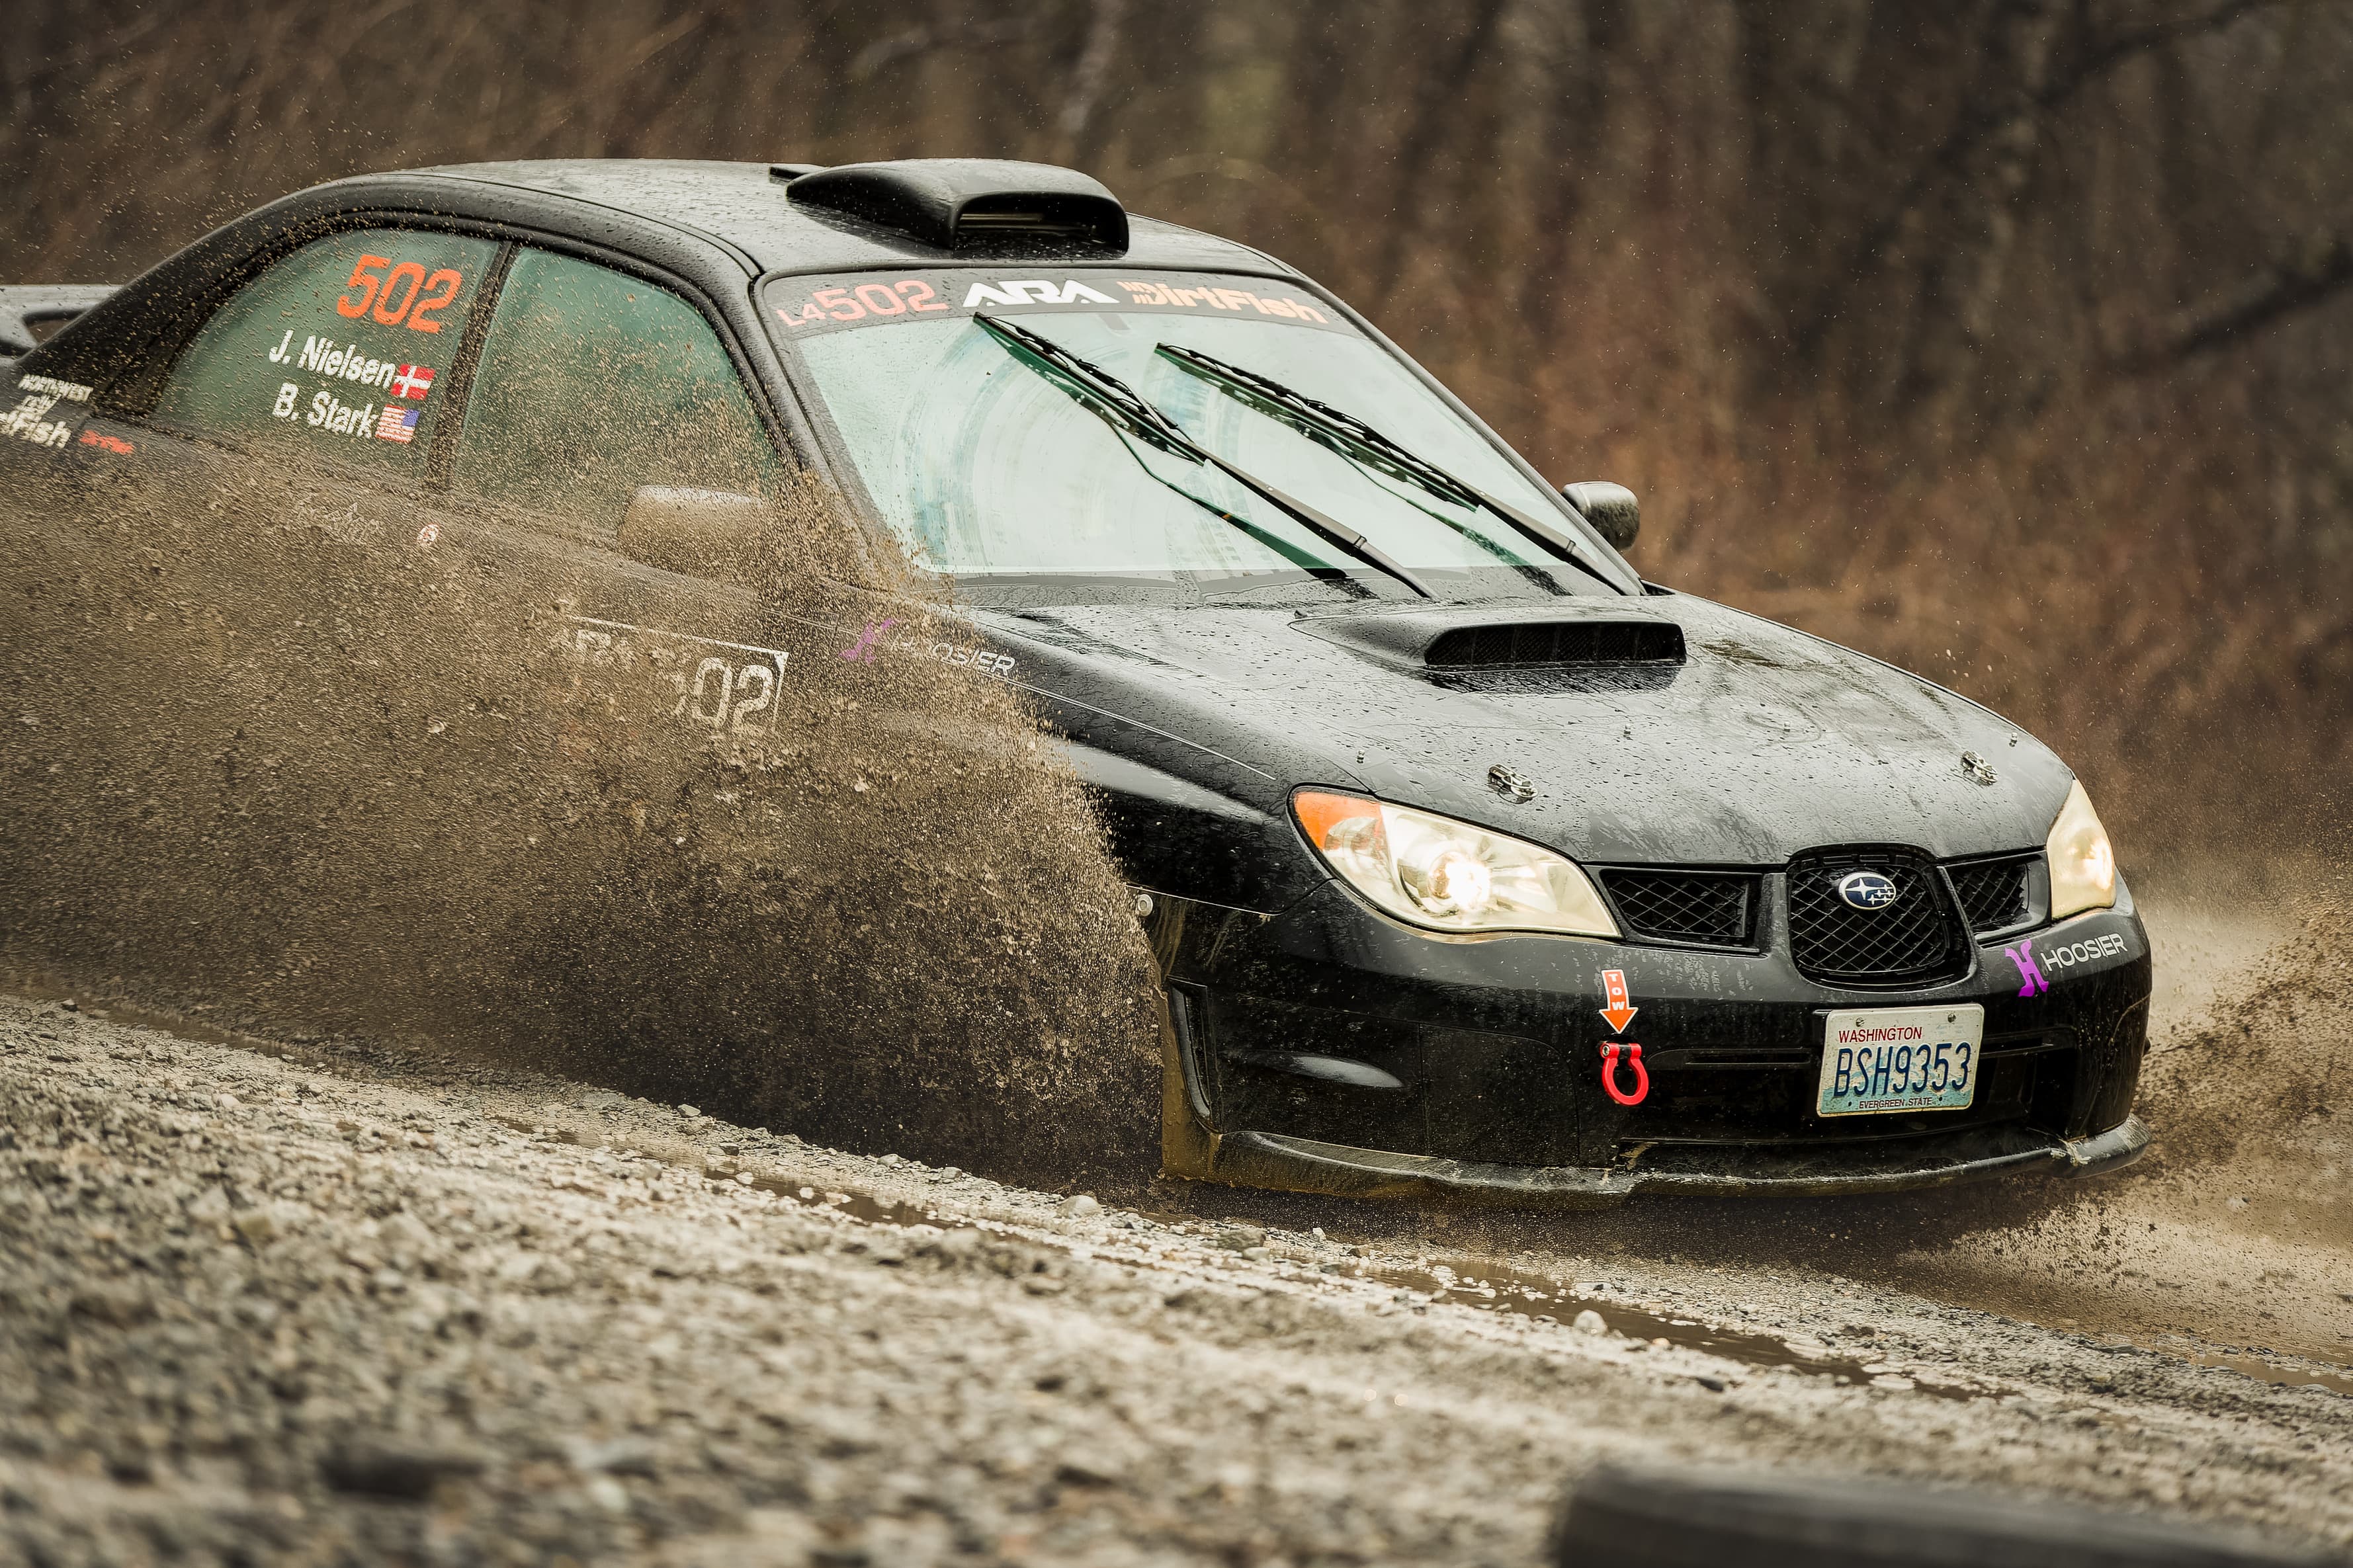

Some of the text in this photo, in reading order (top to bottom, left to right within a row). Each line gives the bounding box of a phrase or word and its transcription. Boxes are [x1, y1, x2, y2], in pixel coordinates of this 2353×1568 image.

[337, 254, 462, 334] 502
[963, 280, 1121, 308] ARA
[1117, 281, 1329, 324] DirtFish
[269, 329, 396, 390] J. Nielsen
[272, 382, 379, 439] B. Stark
[2040, 933, 2128, 972] HOOSIER
[1608, 973, 1625, 1011] TOW
[1838, 1026, 1922, 1044] WASHINGTON
[1833, 1042, 1972, 1097] BSH9353
[1859, 1097, 1933, 1109] EVERGREEN STATE
